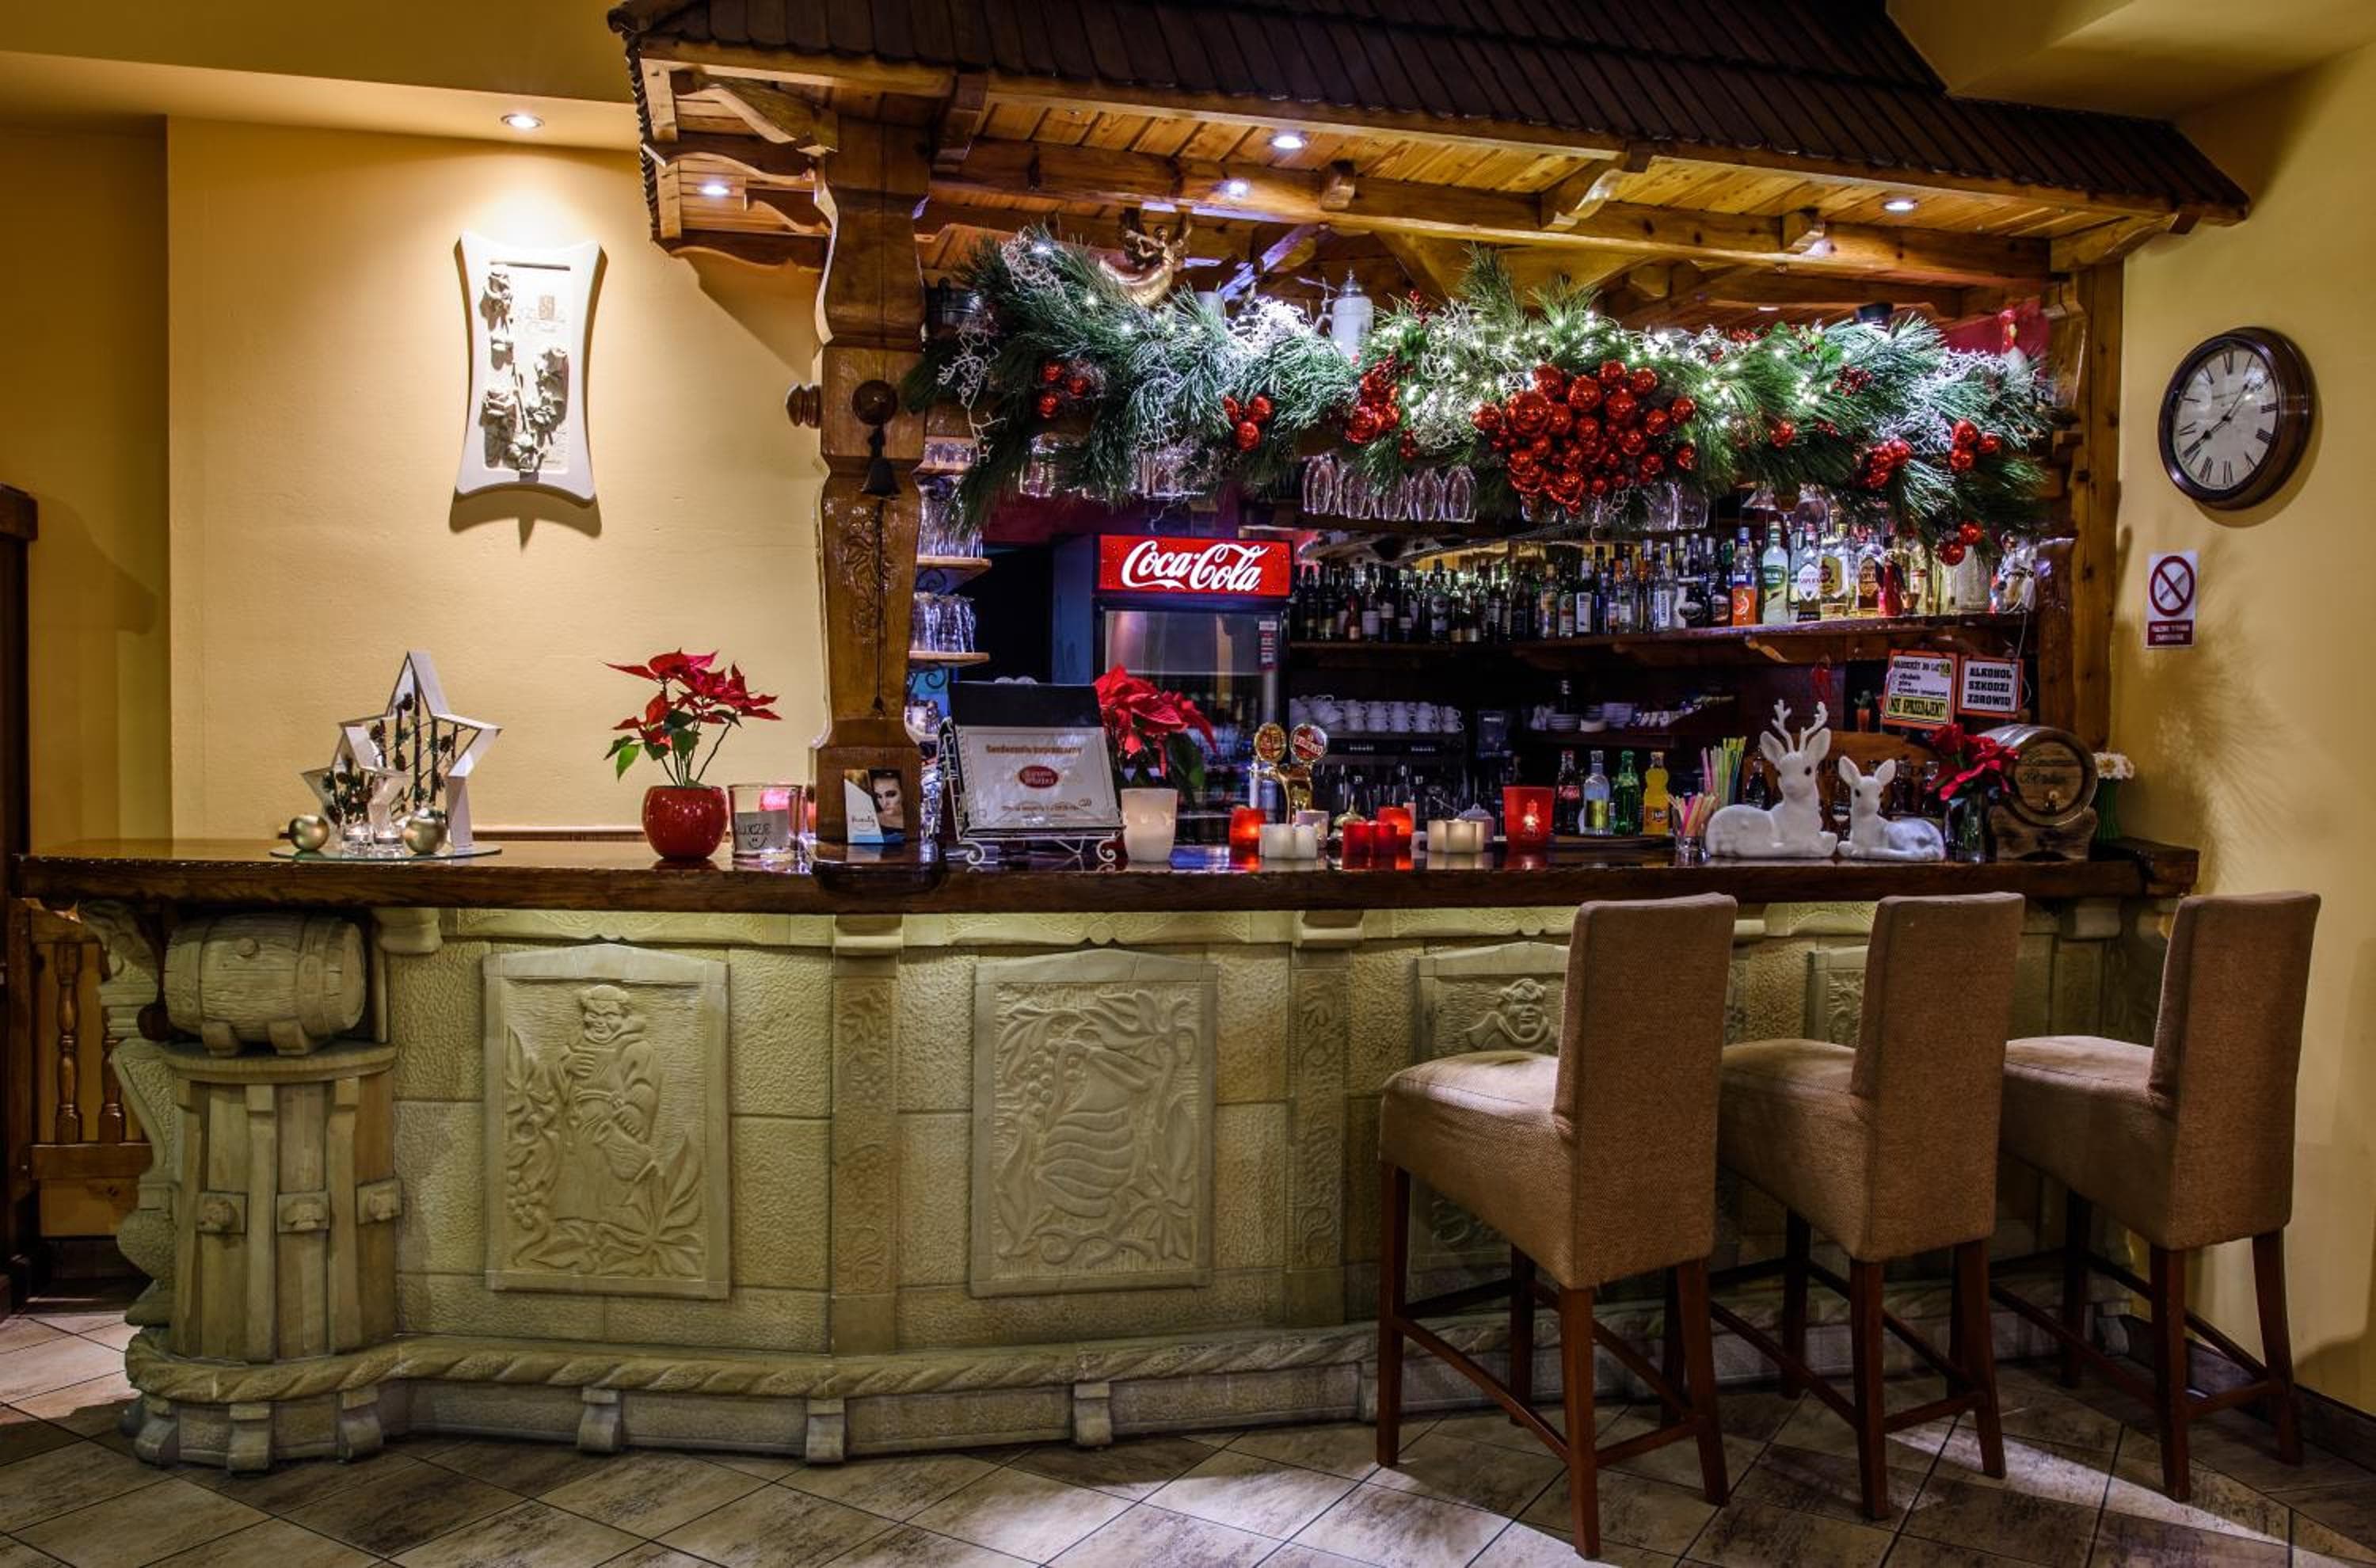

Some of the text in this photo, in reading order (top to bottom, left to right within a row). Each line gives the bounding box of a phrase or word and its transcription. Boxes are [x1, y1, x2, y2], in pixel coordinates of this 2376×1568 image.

[1121, 540, 1269, 592] Coca-Cola
[1969, 667, 2012, 679] ALKOHOL
[1968, 680, 2009, 693] SZKODZI
[1967, 694, 2011, 706] ZDROWIU
